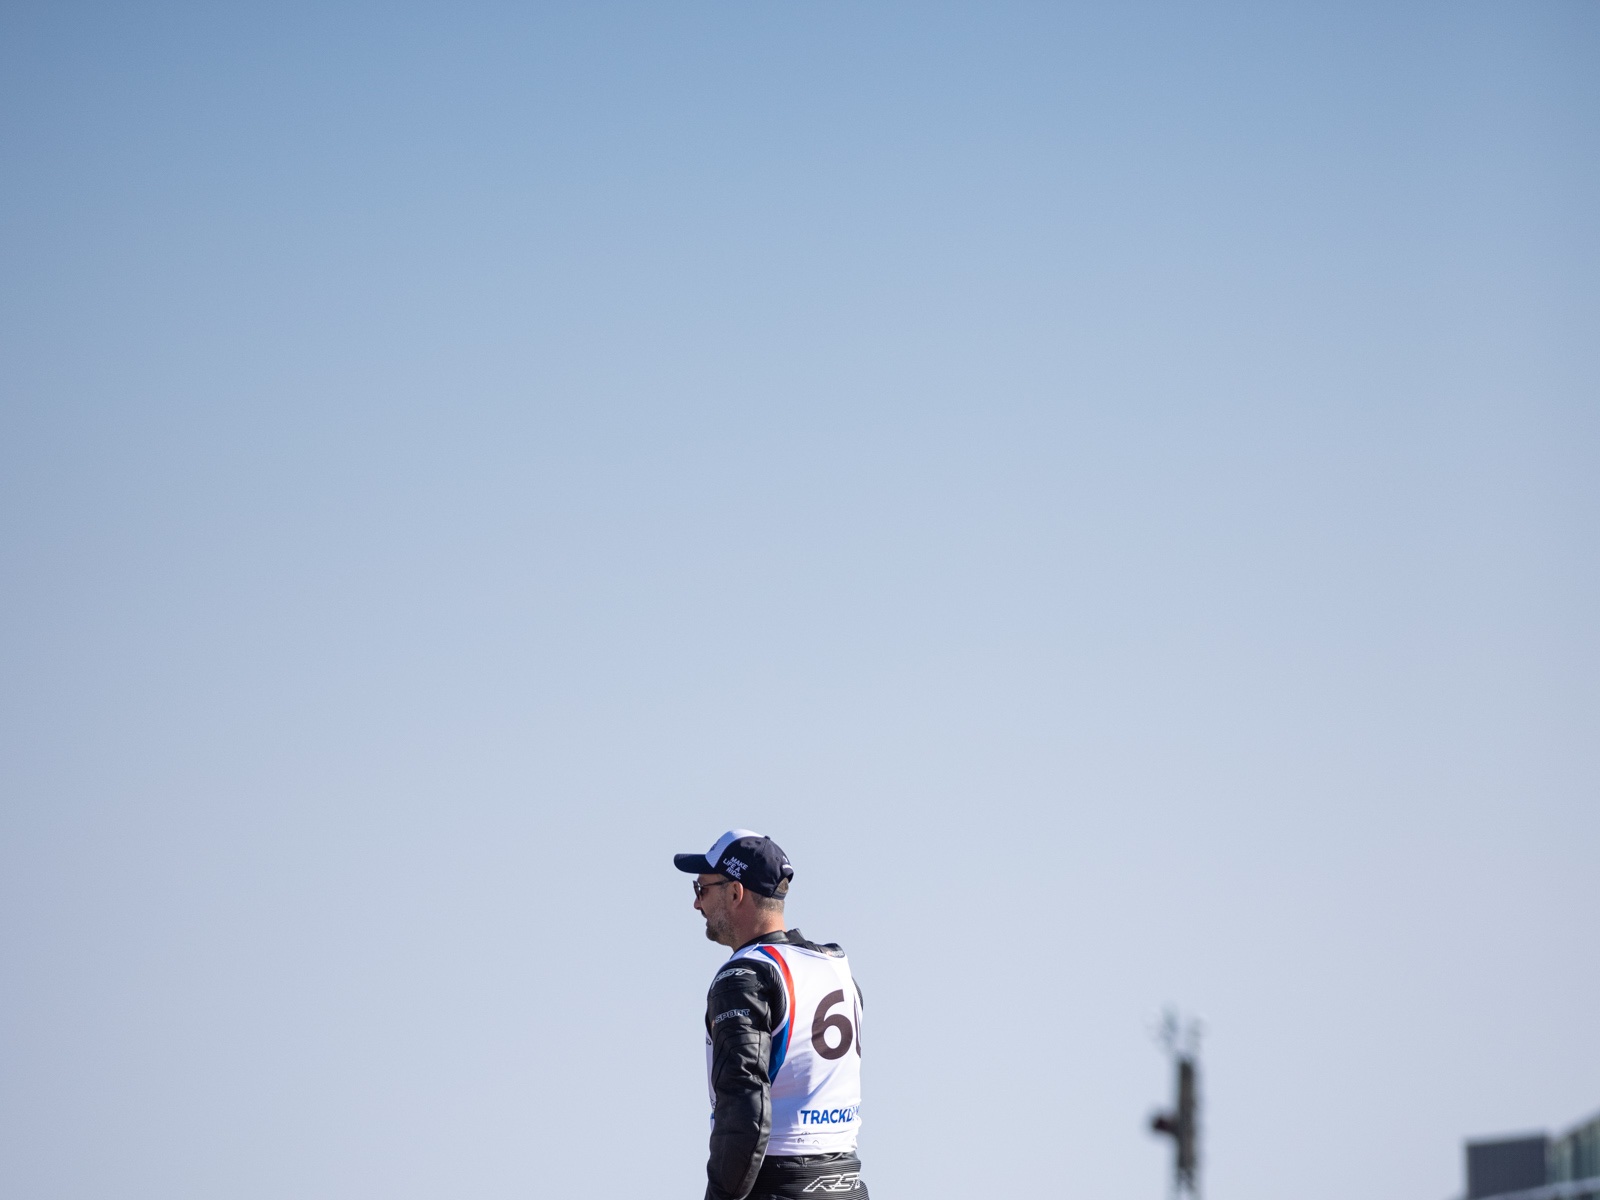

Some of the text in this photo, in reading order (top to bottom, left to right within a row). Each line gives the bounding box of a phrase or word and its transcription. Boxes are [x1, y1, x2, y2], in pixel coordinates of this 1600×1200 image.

[722, 858, 737, 869] LIFE
[730, 856, 749, 871] MAKE
[715, 1008, 751, 1024] SPORT
